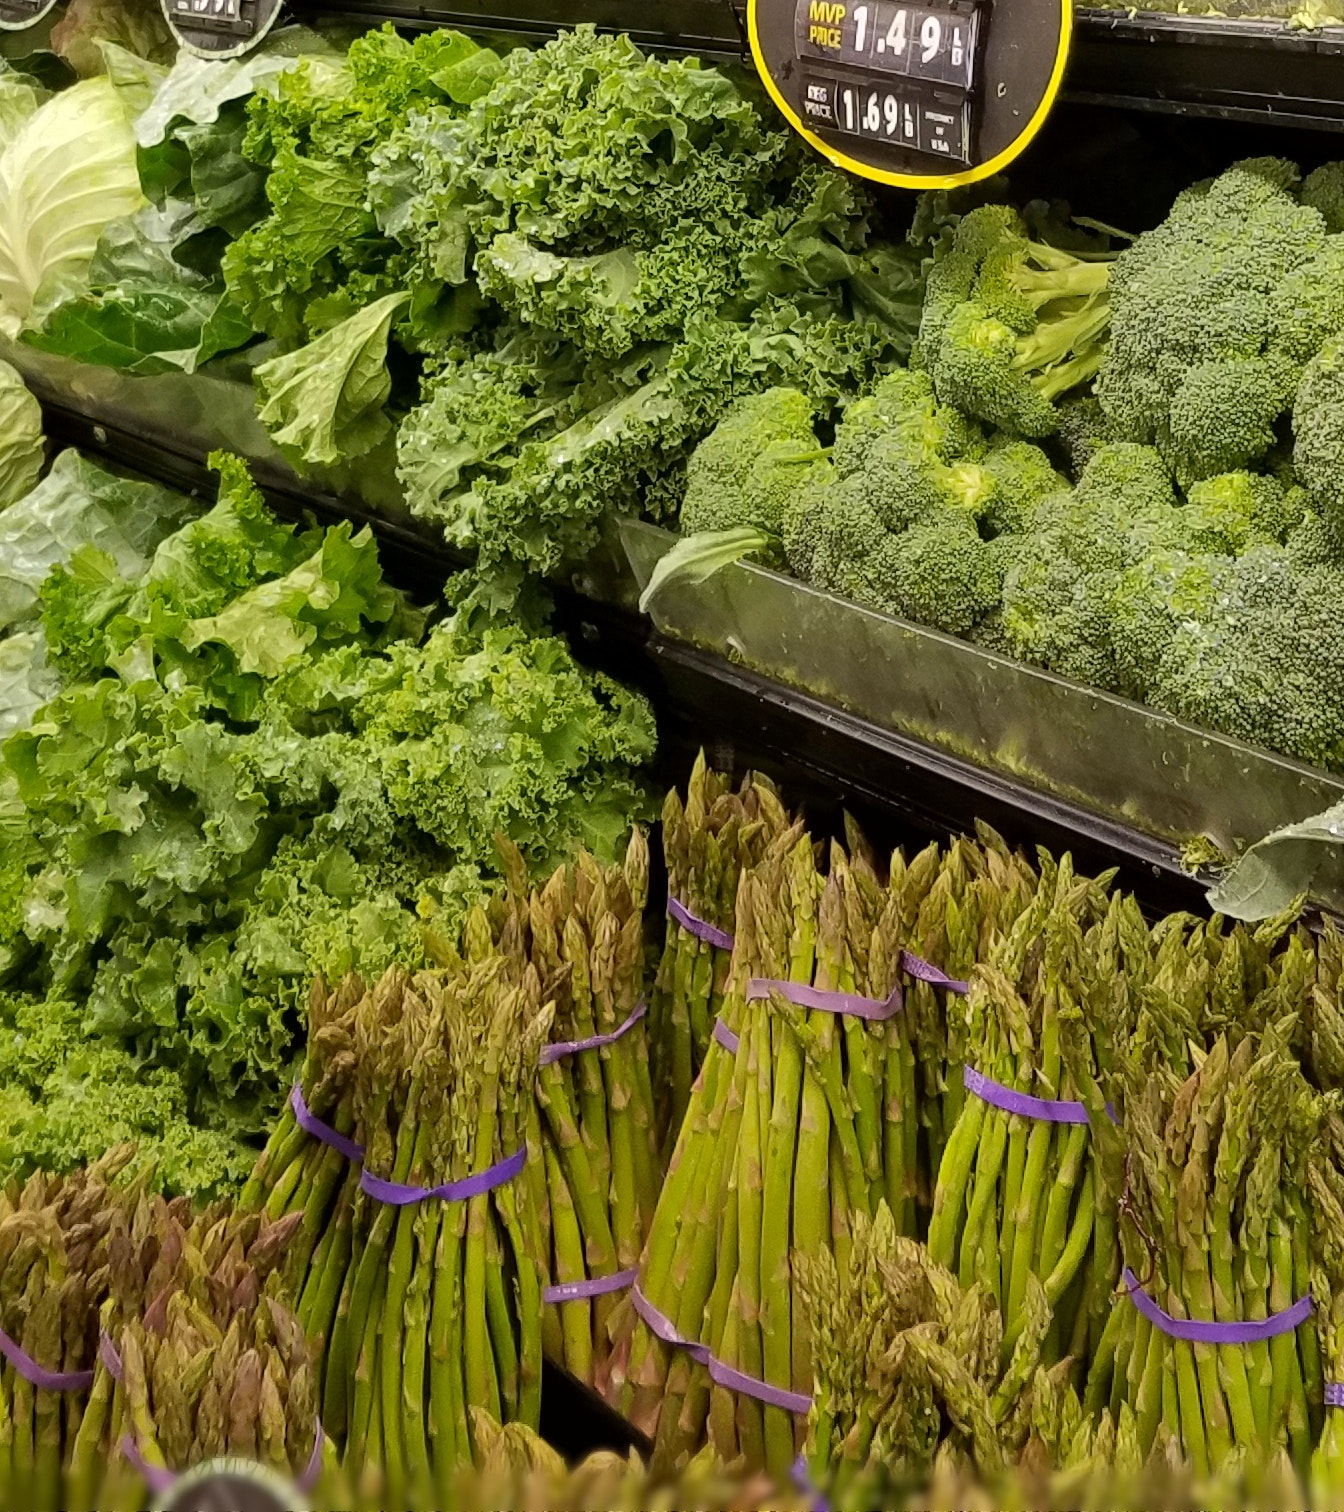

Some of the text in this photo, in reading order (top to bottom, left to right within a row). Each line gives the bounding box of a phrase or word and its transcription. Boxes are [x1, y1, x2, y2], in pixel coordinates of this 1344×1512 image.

[809, 0, 846, 26] MVP
[808, 25, 843, 50] PRICE
[853, 5, 942, 65] 1.49
[843, 89, 899, 136] 1.69
